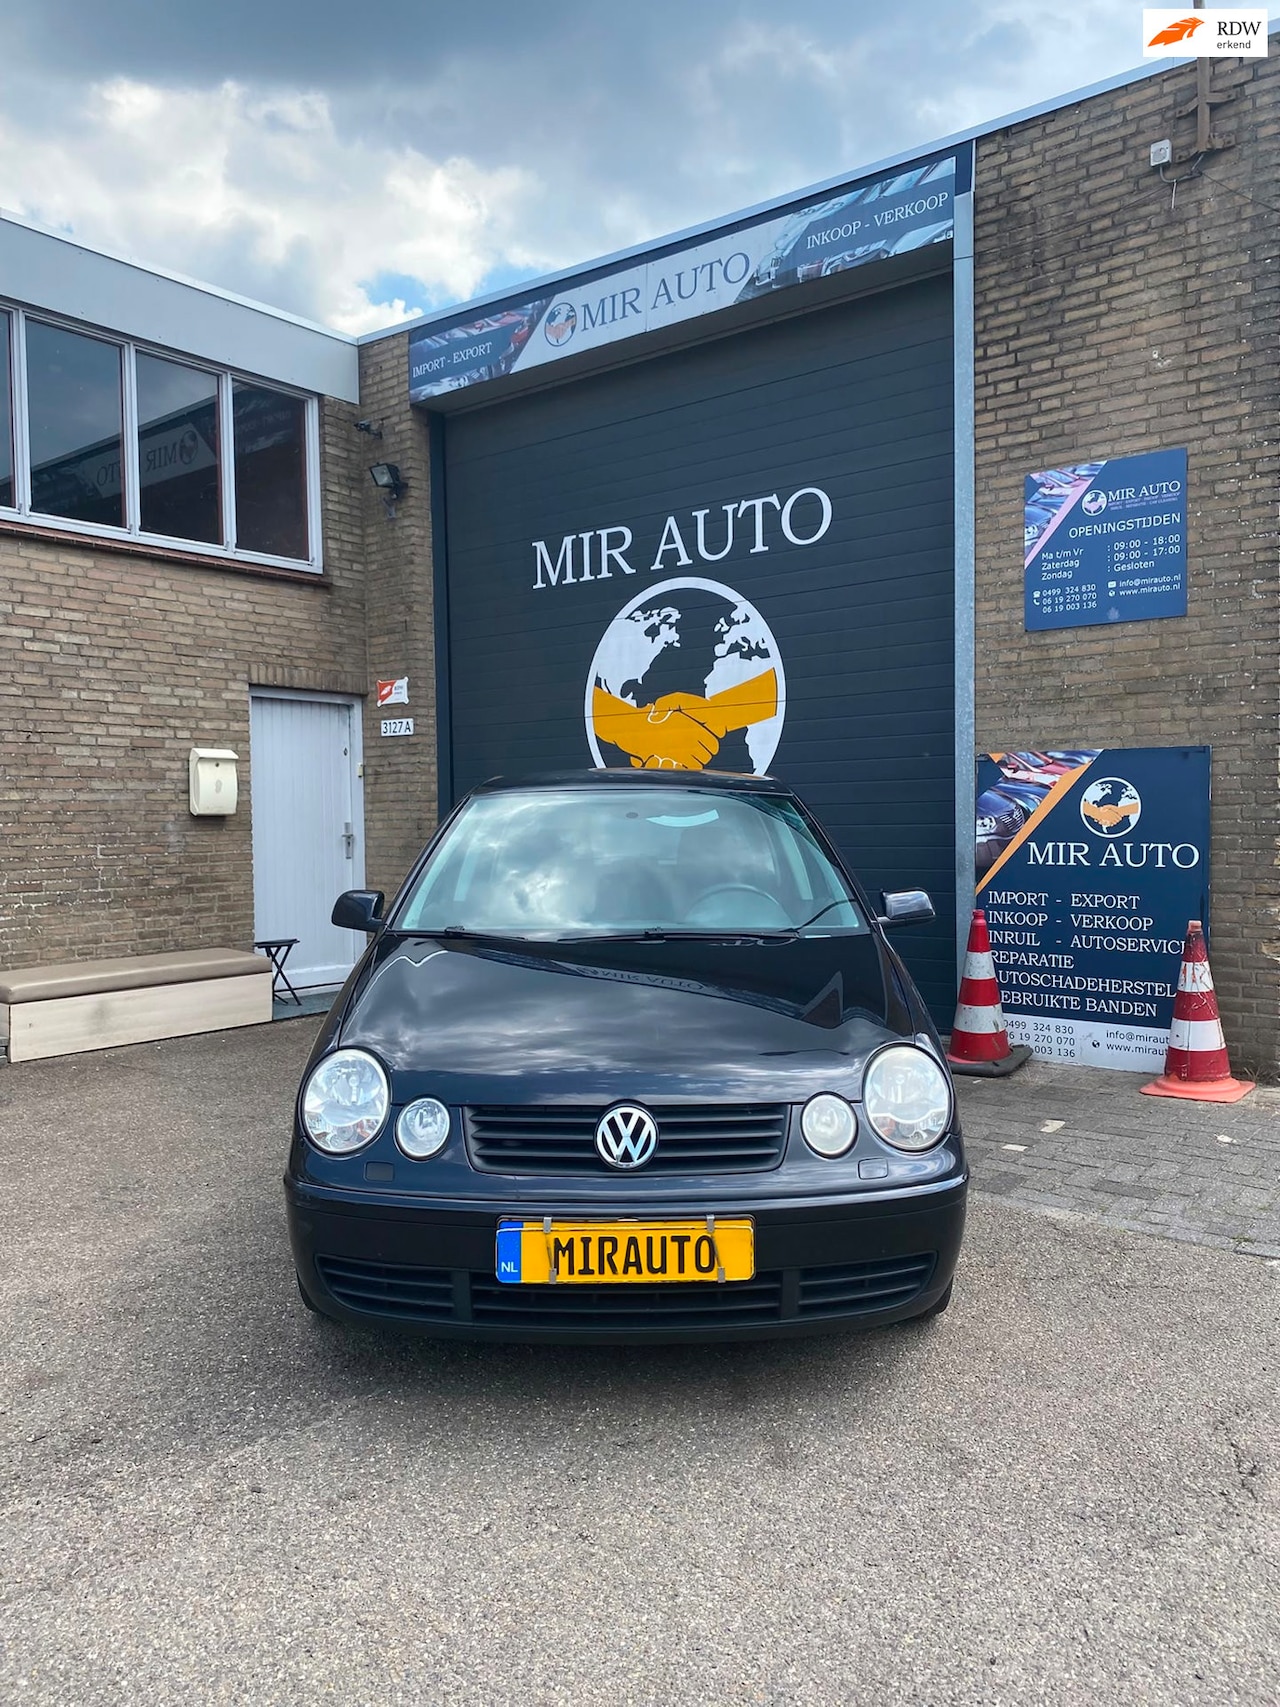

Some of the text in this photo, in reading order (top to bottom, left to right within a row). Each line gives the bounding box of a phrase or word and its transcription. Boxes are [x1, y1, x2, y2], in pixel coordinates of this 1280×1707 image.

[806, 220, 861, 250] INKOOP
[873, 192, 949, 227] VERKOOP
[580, 252, 750, 332] MIR AUTO
[412, 356, 446, 378] IMPORT
[453, 341, 493, 364] EXPORT
[1108, 487, 1136, 503] MIR
[1138, 480, 1181, 498] AUTO
[1068, 512, 1181, 539] OPENINGSTIJDEN
[531, 487, 833, 589] MIR AUTO
[1041, 552, 1054, 560] Ma
[1056, 550, 1072, 559] t/m
[1072, 547, 1084, 556] Vr
[1113, 539, 1141, 551] 09:00
[1152, 533, 1181, 546] 18:00
[1041, 559, 1080, 571] Zaterdag
[1113, 550, 1141, 562] 09:00
[1152, 544, 1181, 557] 17:00
[1041, 570, 1073, 581] Zondag
[1113, 560, 1155, 572] Gesloten
[1119, 573, 1182, 588] info@mirauto.nl
[1042, 583, 1096, 597] 0499 324 830
[1042, 592, 1097, 606] 06 19 270 070
[1119, 582, 1181, 596] www.mirauto.nl
[1042, 600, 1097, 614] 06 19 003 136
[382, 721, 403, 734] 3127
[1027, 842, 1200, 869] MIR AUTO
[988, 890, 1049, 906] IMPORT
[1070, 893, 1140, 910] EXPORT
[988, 910, 1048, 926] INKOOP
[1070, 914, 1154, 931] VERKOOP
[988, 930, 1041, 946] INRUIL
[995, 970, 1177, 998] UTOSCHADEHERSTEL
[1000, 990, 1158, 1017] EBRUIKTE BANDEN
[1033, 1022, 1051, 1032] 324
[1055, 1024, 1074, 1035] 830
[1106, 1030, 1170, 1045] info@miraut
[1020, 1032, 1031, 1041] 19
[1034, 1033, 1053, 1044] 270
[1056, 1036, 1076, 1047] 070
[1034, 1045, 1053, 1056] 003
[1057, 1048, 1076, 1058] 136
[553, 1235, 716, 1275] MIRAUTO
[501, 1261, 518, 1273] NL
